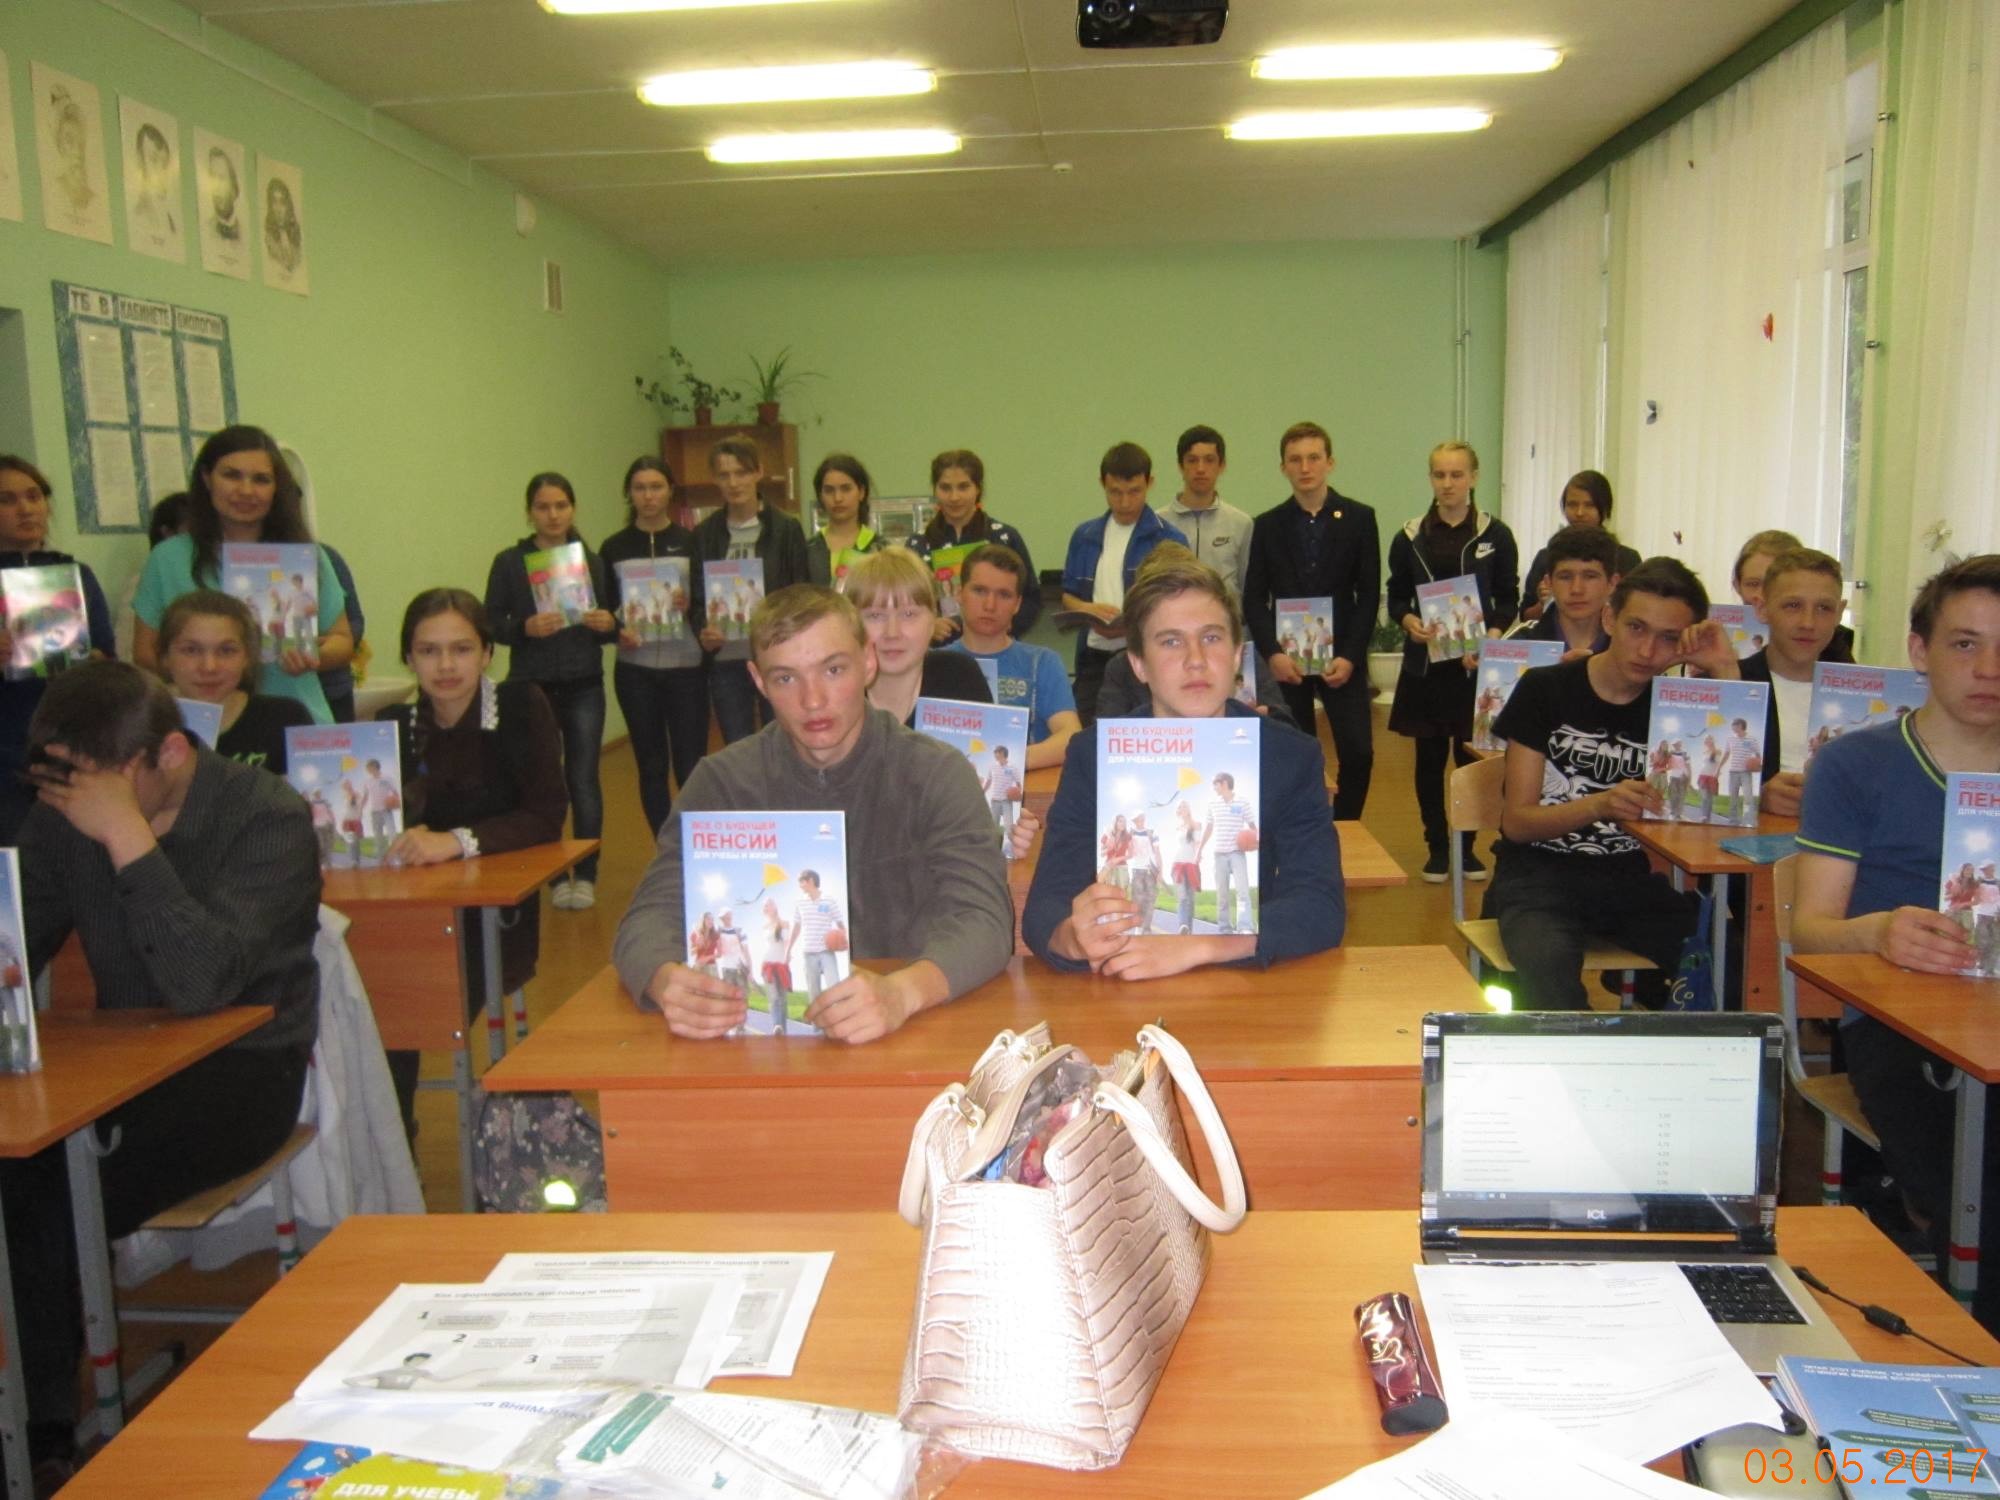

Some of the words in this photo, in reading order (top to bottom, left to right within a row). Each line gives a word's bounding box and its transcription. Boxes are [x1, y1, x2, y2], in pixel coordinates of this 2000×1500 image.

[71, 290, 90, 311] ТБ
[99, 296, 109, 315] В
[1821, 675, 1884, 690] ПЕНСИИ
[1659, 690, 1720, 704] ПЕНСИИ
[923, 711, 982, 729] ПЕНСИИ
[1108, 727, 1128, 736] ВСЕ
[1131, 727, 1139, 735] О
[1142, 727, 1193, 737] БУДУЩЕЙ
[1108, 738, 1193, 754] ПЕНСИИ
[1548, 735, 1649, 782] VENU
[713, 822, 723, 830] О
[692, 833, 777, 850] ПЕНСИИ
[1587, 1208, 1606, 1219] ICL
[417, 1311, 429, 1320] 1
[452, 1333, 467, 1343] 2
[523, 1354, 539, 1364] 3
[332, 1483, 389, 1498] ДЛЯ
[393, 1484, 480, 1500] УЧЕБЫ
